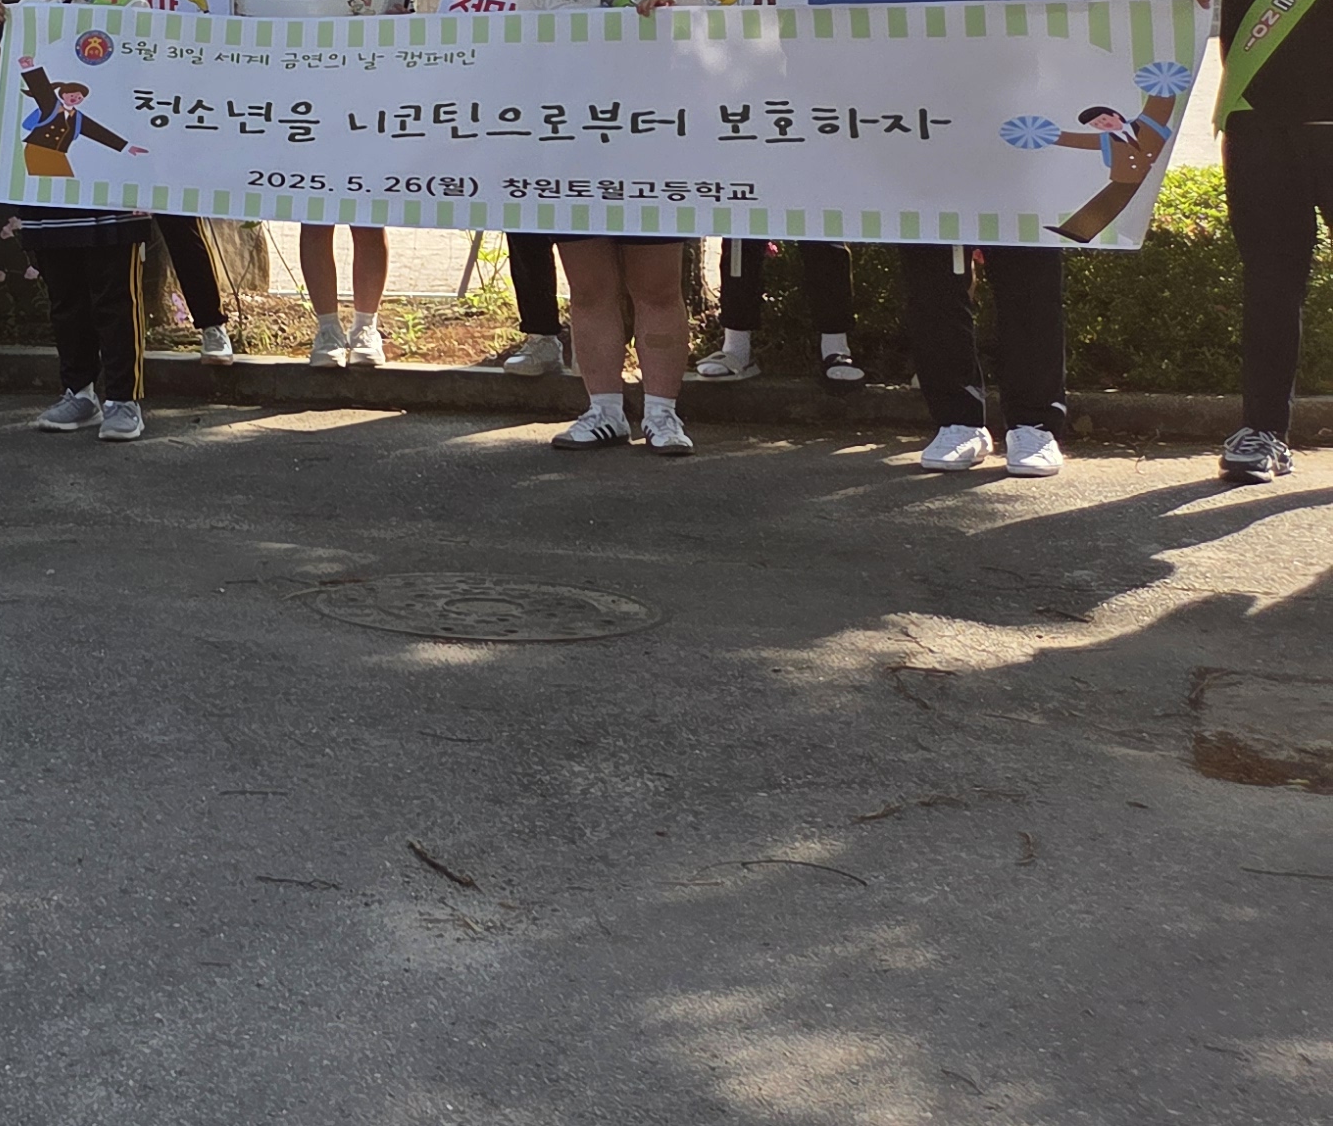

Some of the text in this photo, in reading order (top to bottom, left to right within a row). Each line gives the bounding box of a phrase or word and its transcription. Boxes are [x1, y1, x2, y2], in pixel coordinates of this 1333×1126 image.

[1243, 8, 1281, 52] NO!
[120, 41, 158, 62] 5월
[166, 46, 204, 65] 31일
[214, 51, 270, 66] 세계
[280, 52, 347, 70] 금연의
[358, 52, 385, 71] 날
[395, 49, 476, 70] 캠페인
[132, 89, 953, 144] 청소년을 니코틴으로부터 보호하자
[247, 170, 759, 202] 2025. 5. 26(월) 창원토월고등학교
